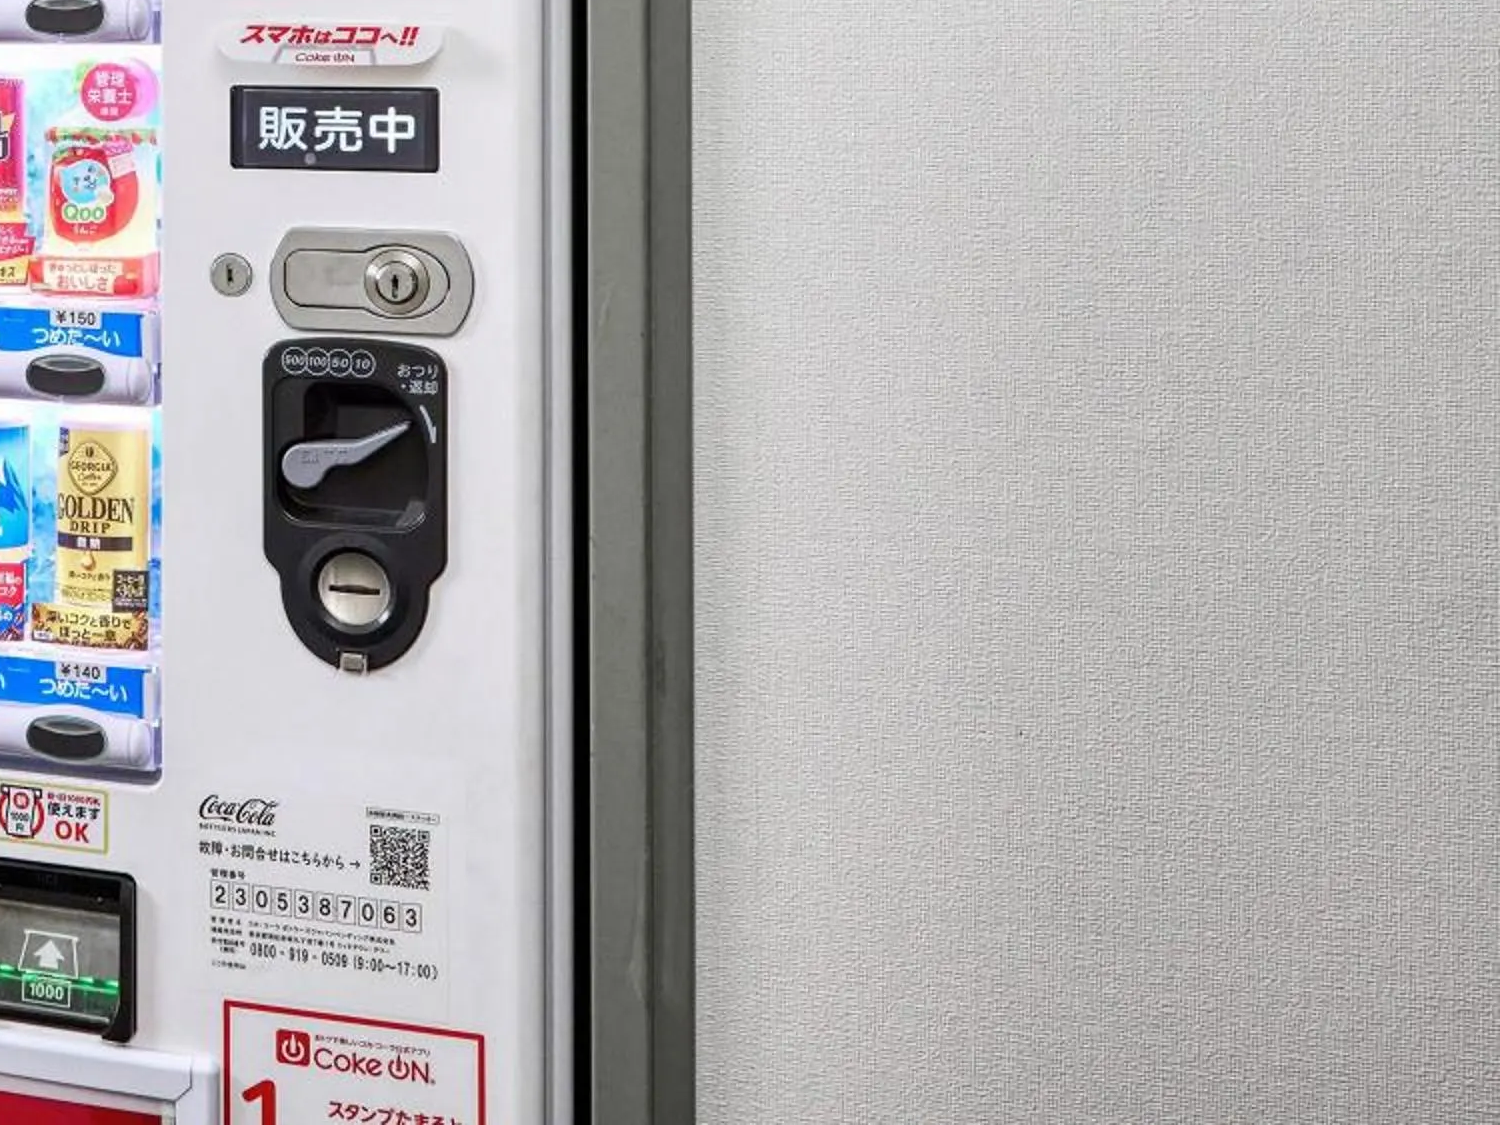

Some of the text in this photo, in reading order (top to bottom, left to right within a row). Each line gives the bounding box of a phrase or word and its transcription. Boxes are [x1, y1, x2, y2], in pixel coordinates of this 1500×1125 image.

[239, 24, 420, 46] スマホはココへ!!
[295, 52, 331, 63] Coke
[258, 106, 415, 154] 販売中
[63, 204, 105, 221] Qoo
[56, 311, 97, 326] ¥150
[354, 359, 371, 370] 10
[397, 365, 439, 378] おつり
[58, 492, 135, 524] GOLDEN
[69, 521, 112, 534] DRIP
[60, 662, 101, 679] ¥140
[47, 802, 101, 820] 使えます
[55, 820, 89, 844] OK
[199, 840, 345, 870] 故障・お問合せはこちらから
[29, 983, 65, 1001] 1000
[314, 1048, 430, 1085] Coke ON
